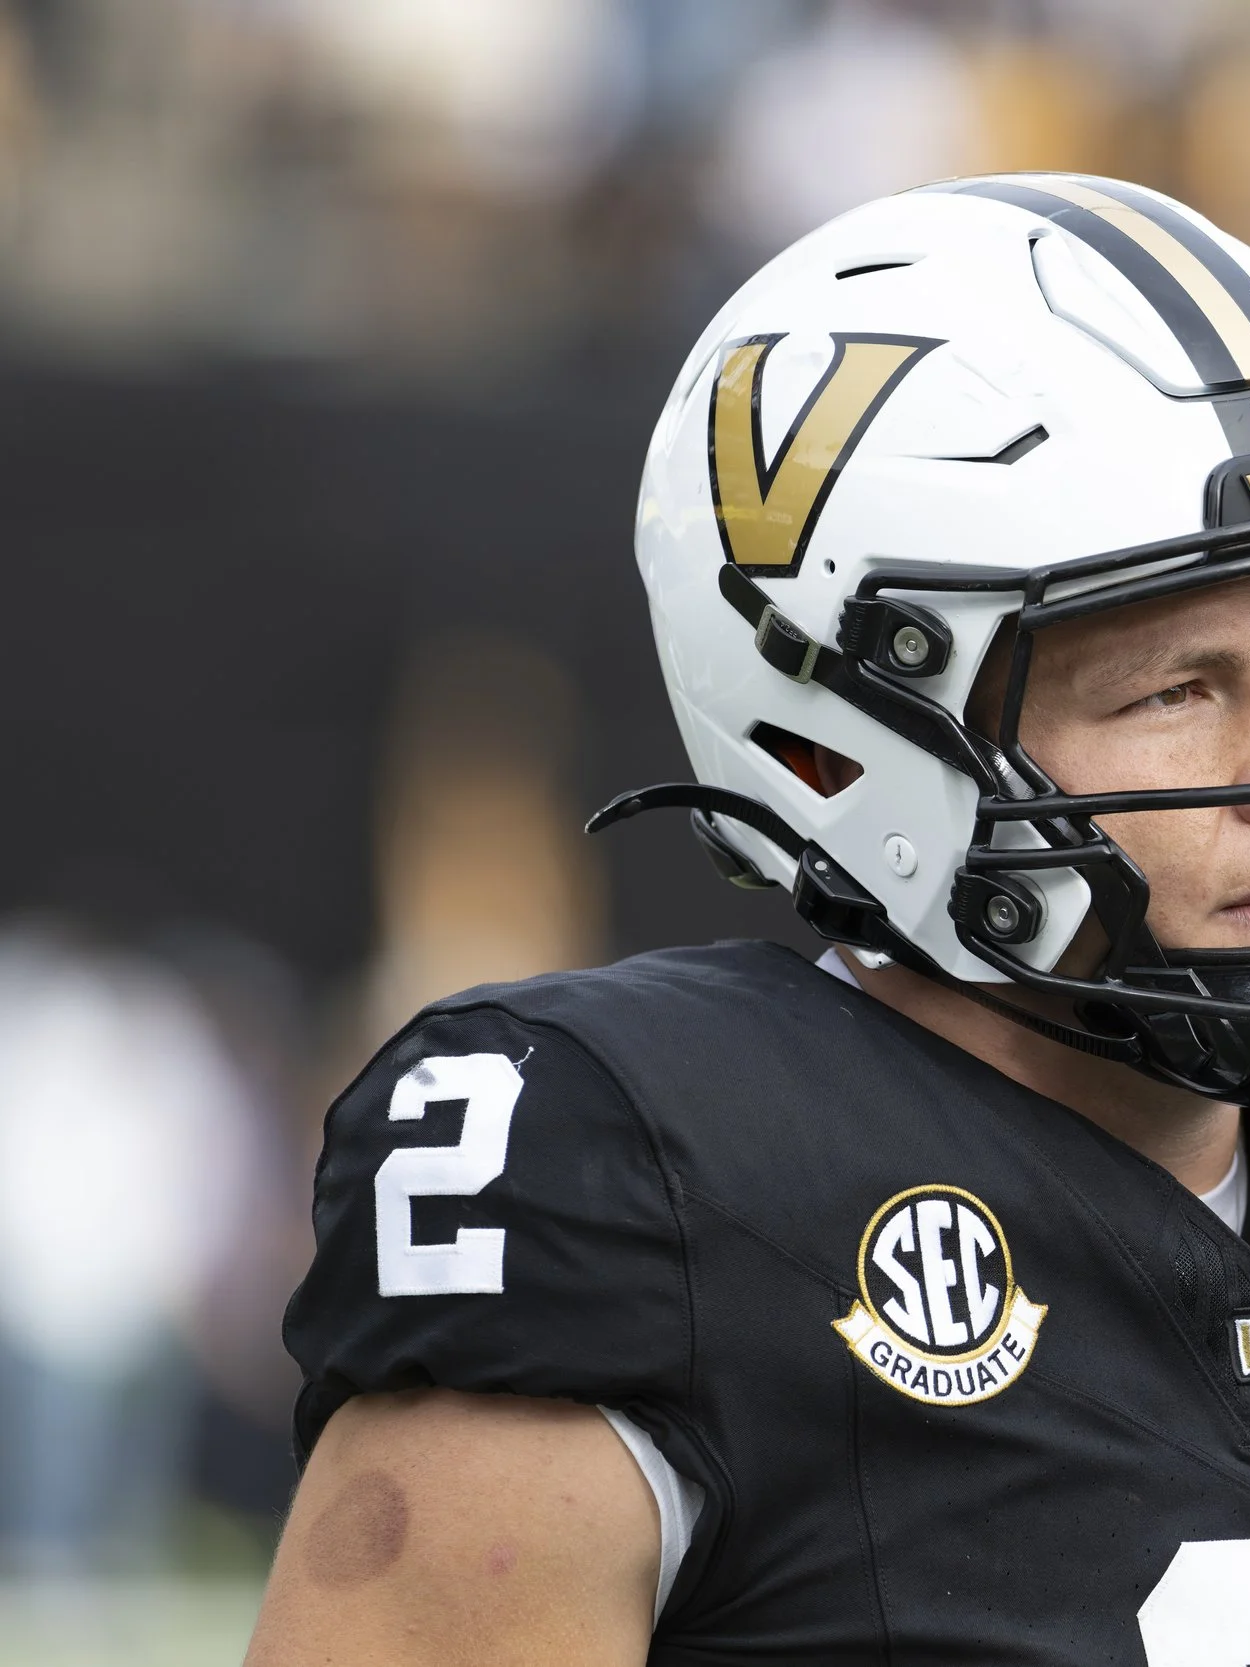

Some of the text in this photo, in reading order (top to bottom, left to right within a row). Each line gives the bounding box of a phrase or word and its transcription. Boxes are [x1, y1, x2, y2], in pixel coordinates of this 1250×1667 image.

[707, 332, 949, 578] V
[374, 1052, 525, 1298] 2
[871, 1199, 1000, 1348] SEC
[869, 1332, 1026, 1398] GRADUATE
